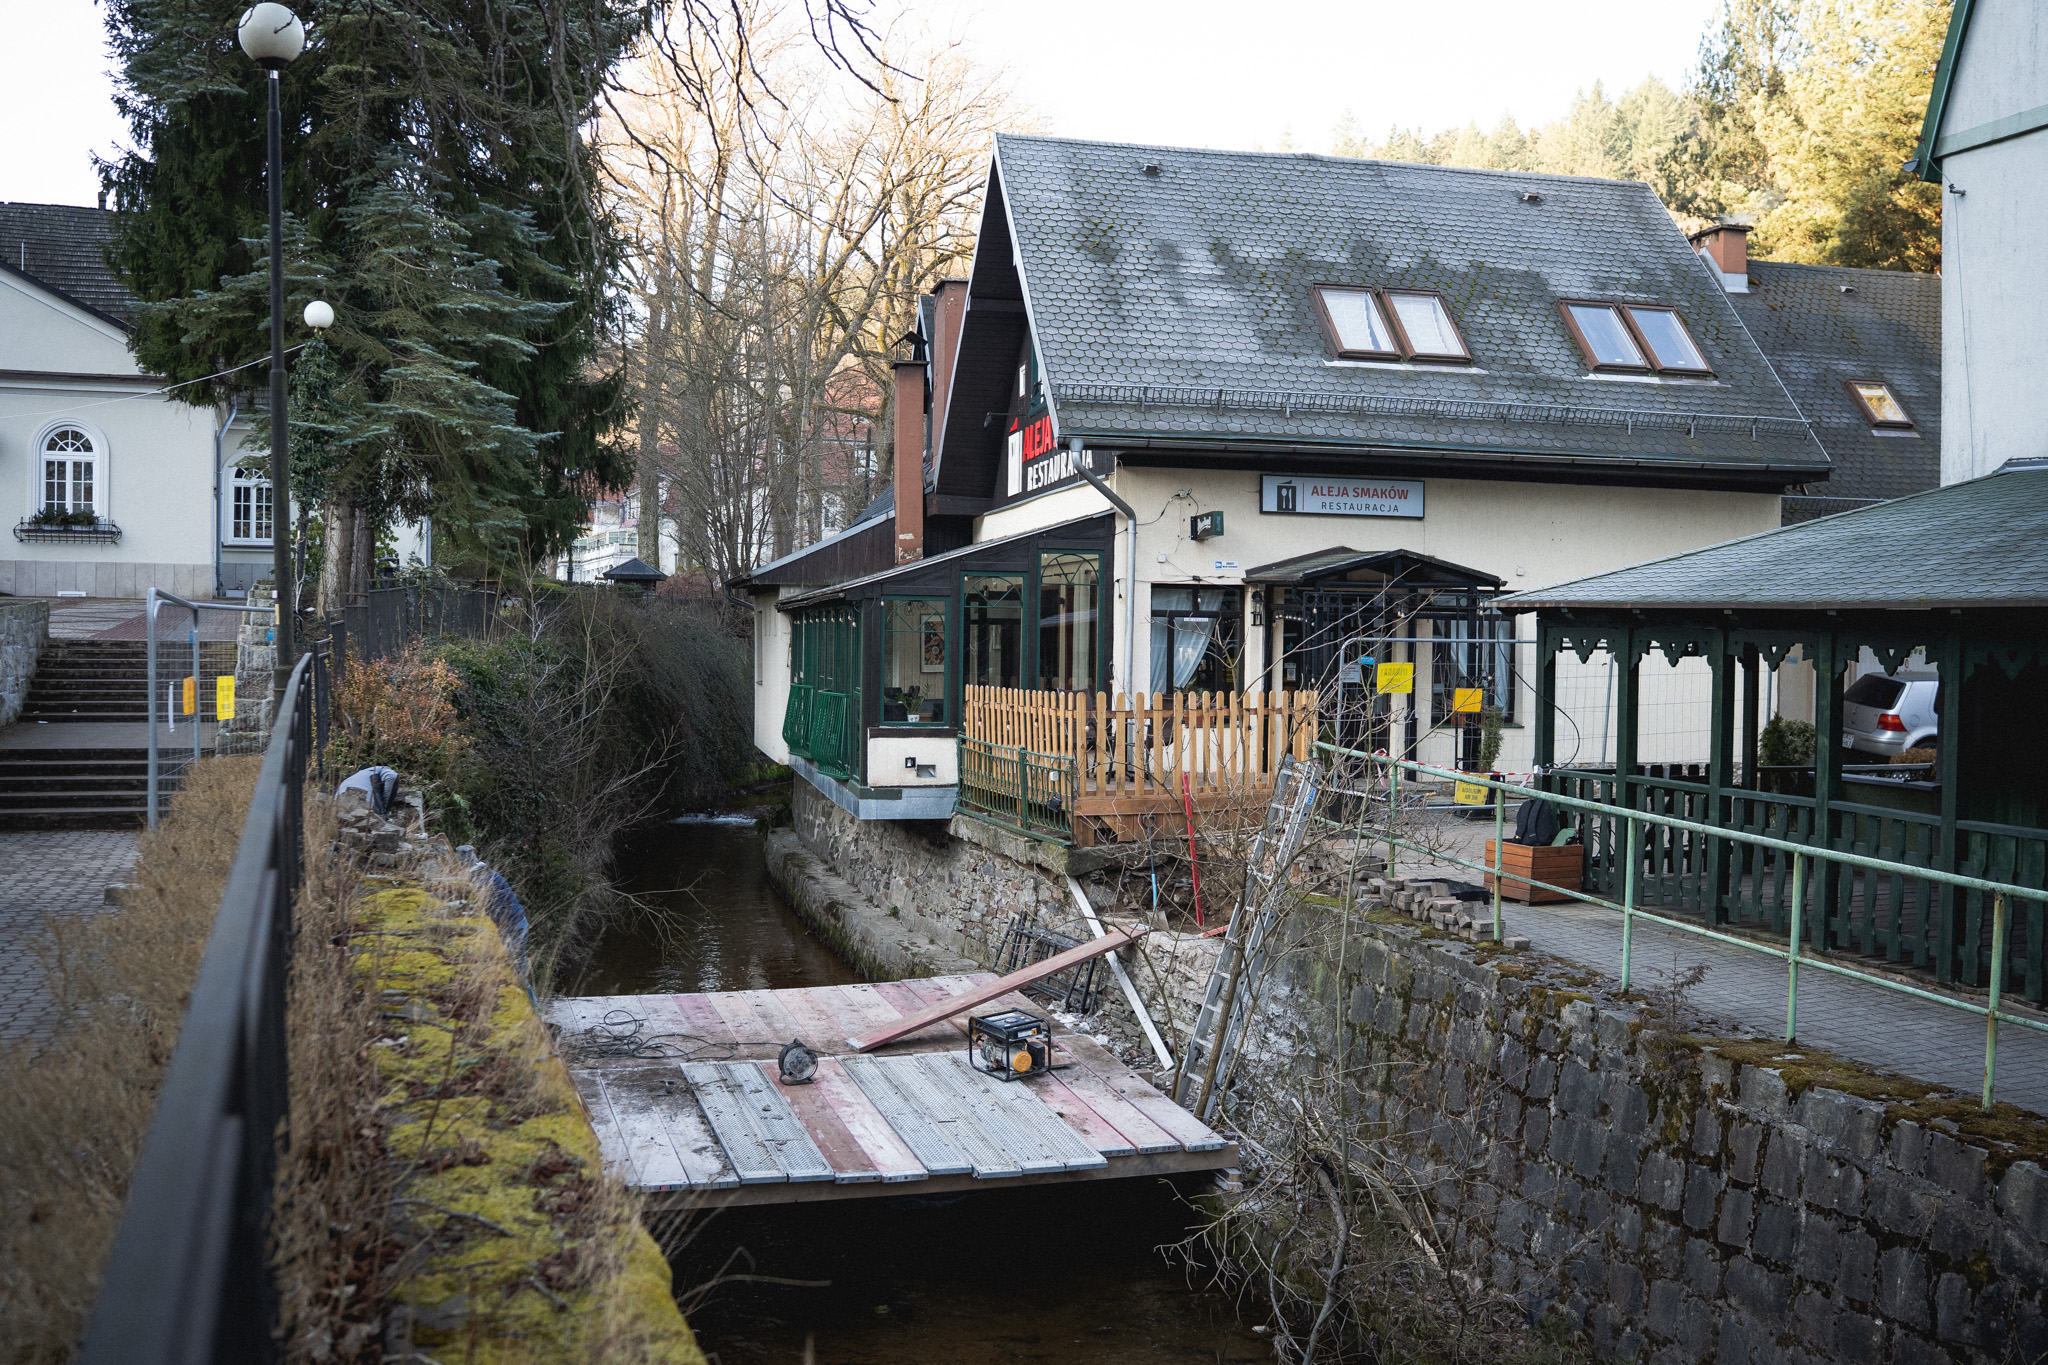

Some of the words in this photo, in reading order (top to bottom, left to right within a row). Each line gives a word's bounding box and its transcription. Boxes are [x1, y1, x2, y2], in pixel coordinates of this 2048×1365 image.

[1022, 415, 1053, 463] ALEJA
[1027, 450, 1093, 492] RESTAURAJA
[1311, 485, 1349, 498] ALEJA
[1352, 485, 1409, 500] SMAKÓW
[1321, 501, 1399, 513] RESTAURACJA
